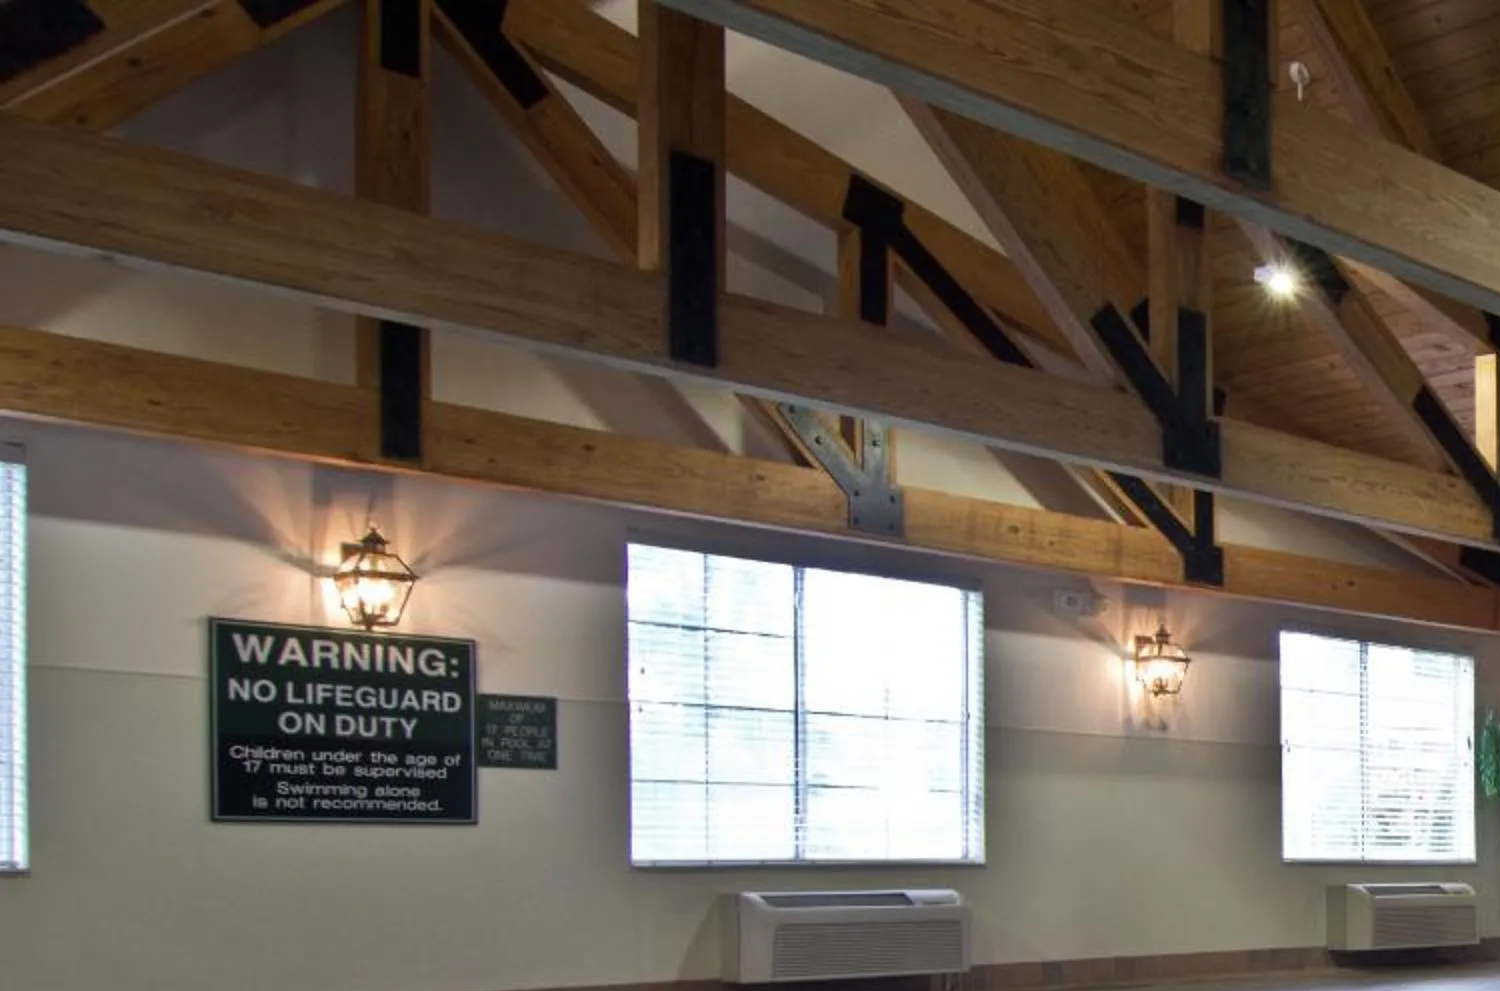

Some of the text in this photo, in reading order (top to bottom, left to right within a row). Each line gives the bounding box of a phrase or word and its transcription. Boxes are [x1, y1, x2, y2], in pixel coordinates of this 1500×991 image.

[231, 632, 459, 678] WARNING:
[229, 678, 462, 713] NO LIFEGUARD
[278, 711, 418, 739] ON DUTY
[229, 745, 462, 767] Children under the age of
[242, 760, 447, 779] 17 must be supervised
[277, 781, 420, 799] Swimming alone
[275, 796, 305, 809] not
[313, 797, 444, 812] recommended.
